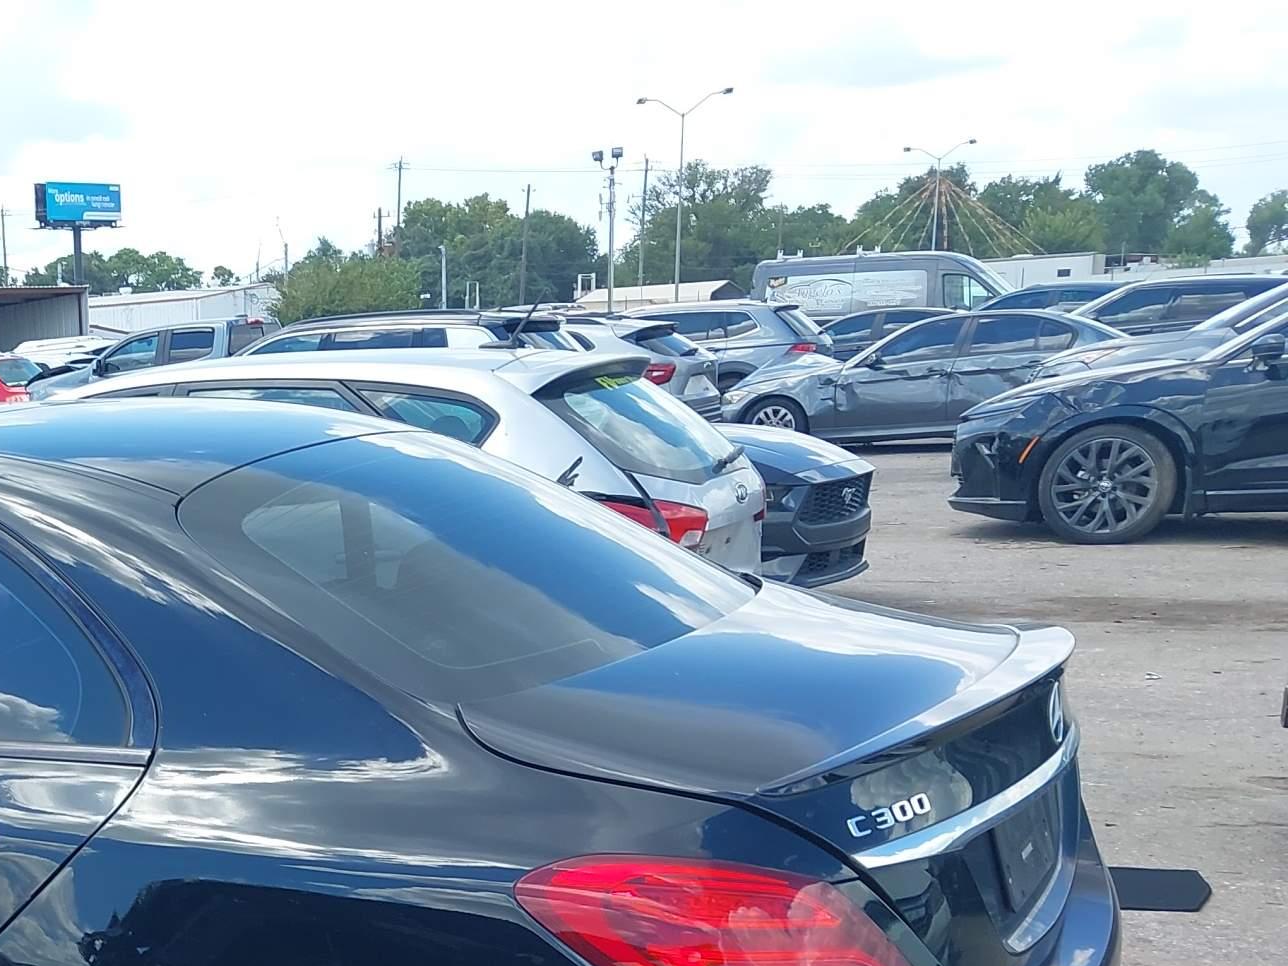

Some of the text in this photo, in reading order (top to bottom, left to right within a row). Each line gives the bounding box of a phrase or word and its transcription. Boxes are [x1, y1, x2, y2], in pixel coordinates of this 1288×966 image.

[55, 191, 84, 206] options
[846, 792, 932, 838] C 300
